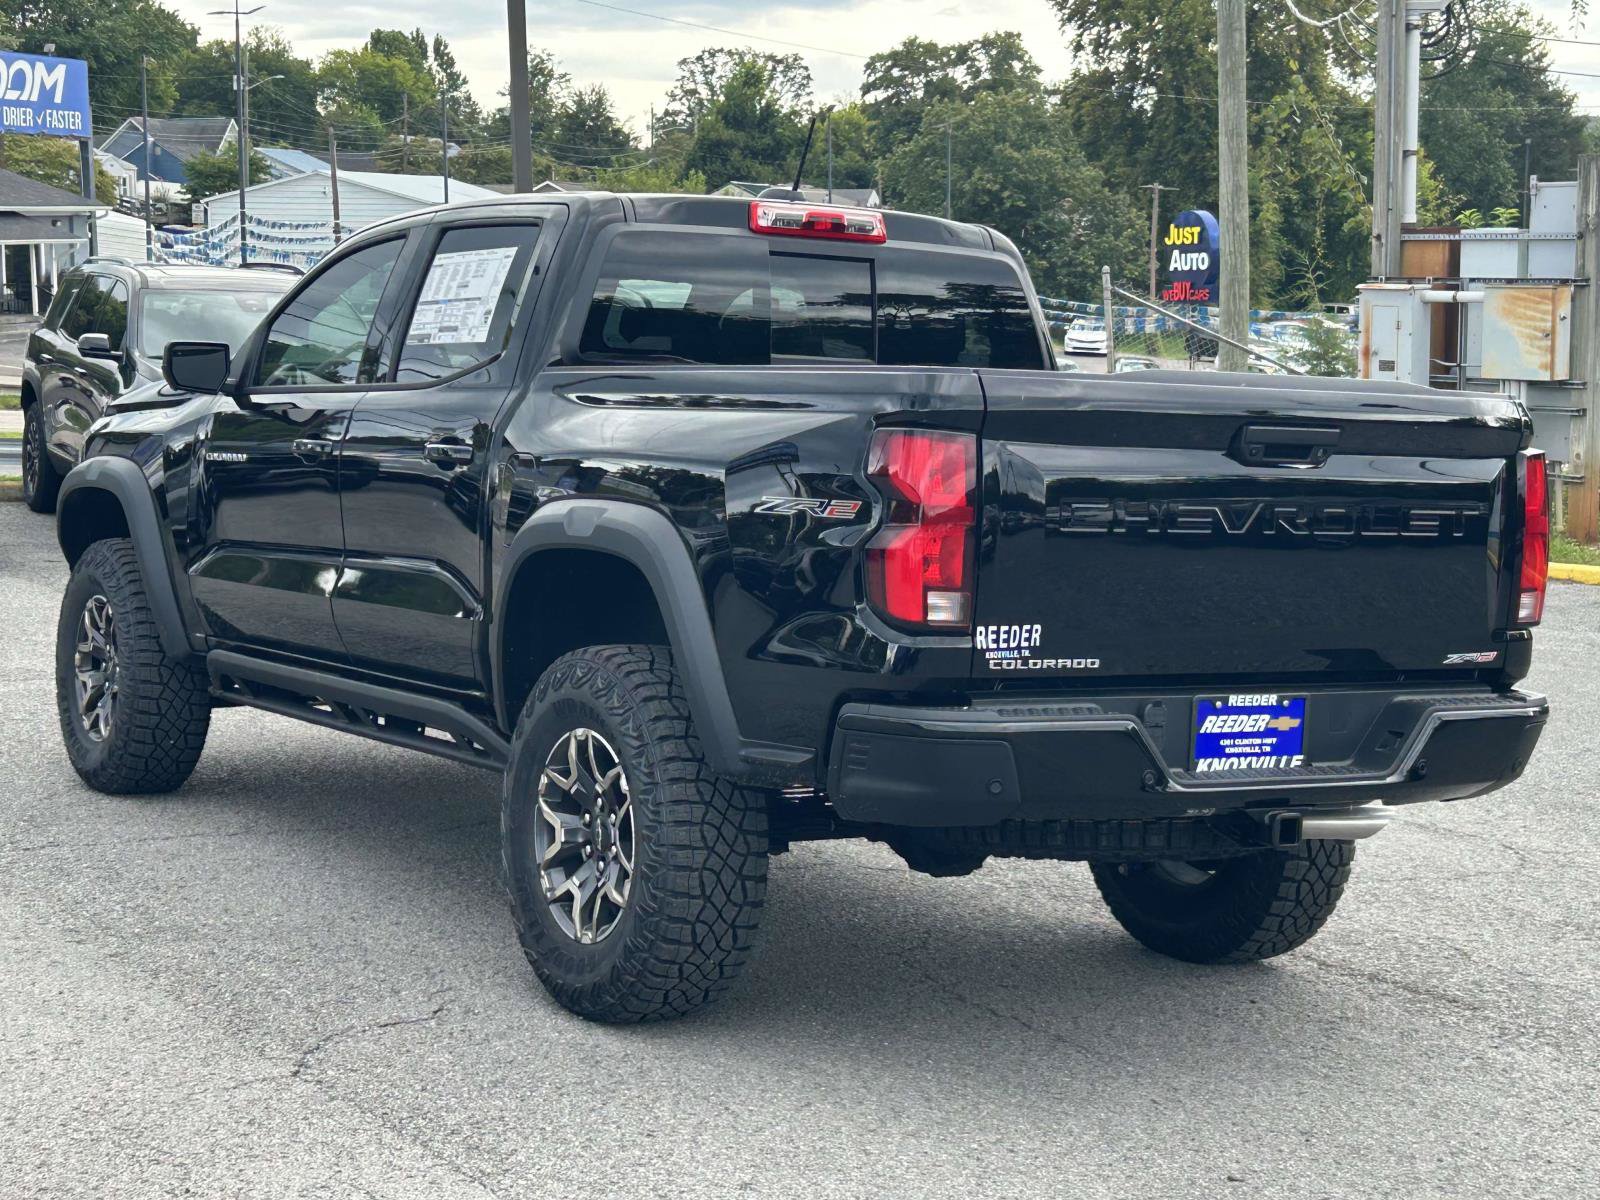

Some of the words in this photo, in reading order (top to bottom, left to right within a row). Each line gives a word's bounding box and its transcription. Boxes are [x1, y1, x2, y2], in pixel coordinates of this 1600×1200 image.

[3, 106, 33, 127] DRIER
[46, 109, 82, 130] FASTER
[1164, 223, 1200, 245] JUST
[1169, 249, 1209, 271] AUTO
[1173, 280, 1191, 300] BUY
[1190, 288, 1209, 300] CARS
[754, 495, 862, 519] ZR2
[1059, 501, 1484, 537] CHEVROLET
[976, 624, 1042, 649] REEDER
[988, 658, 1100, 669] COLORADO
[1228, 694, 1278, 706] REEDER
[1199, 714, 1271, 733] REEDER
